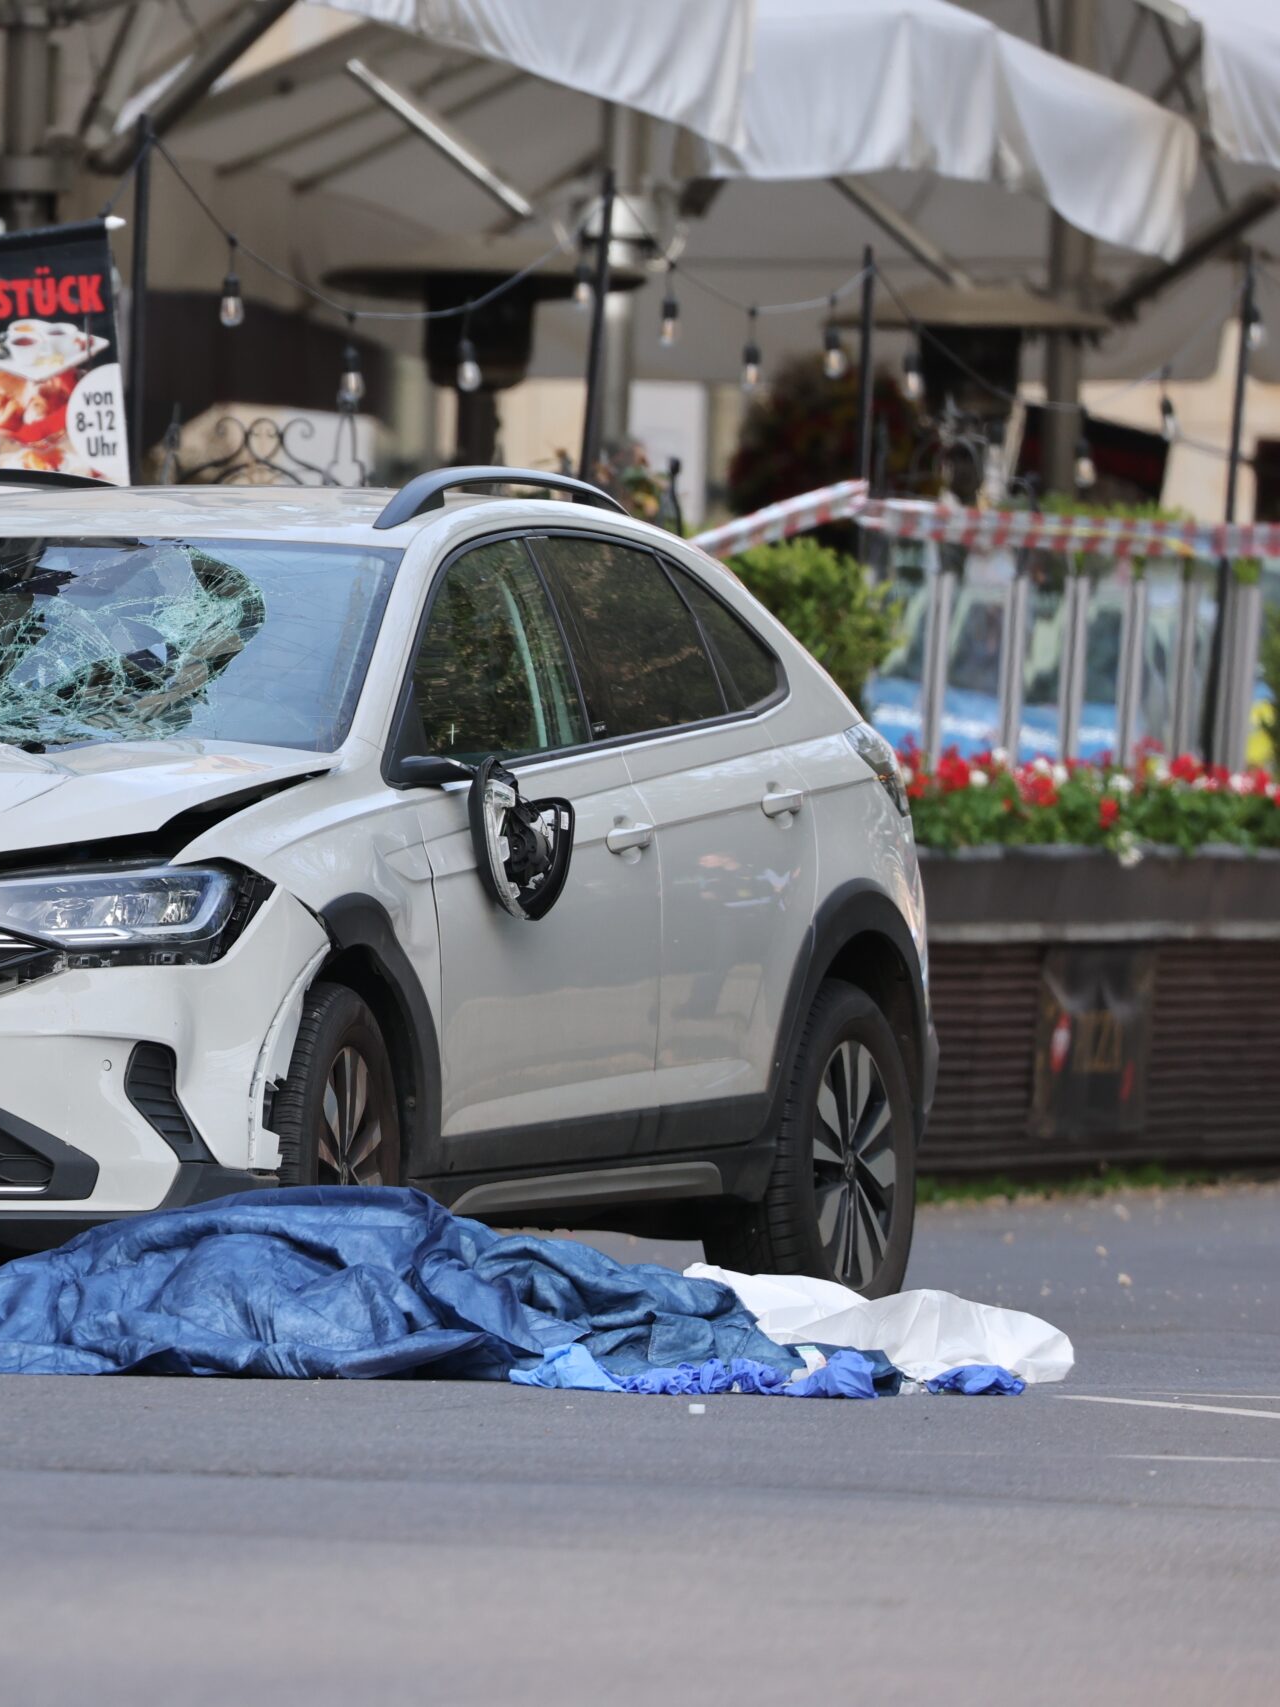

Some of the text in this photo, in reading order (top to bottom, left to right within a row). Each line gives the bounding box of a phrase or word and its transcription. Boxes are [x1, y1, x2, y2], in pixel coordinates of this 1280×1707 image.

[83, 391, 114, 407] von
[76, 410, 116, 433] 8-12
[86, 436, 118, 457] Uhr
